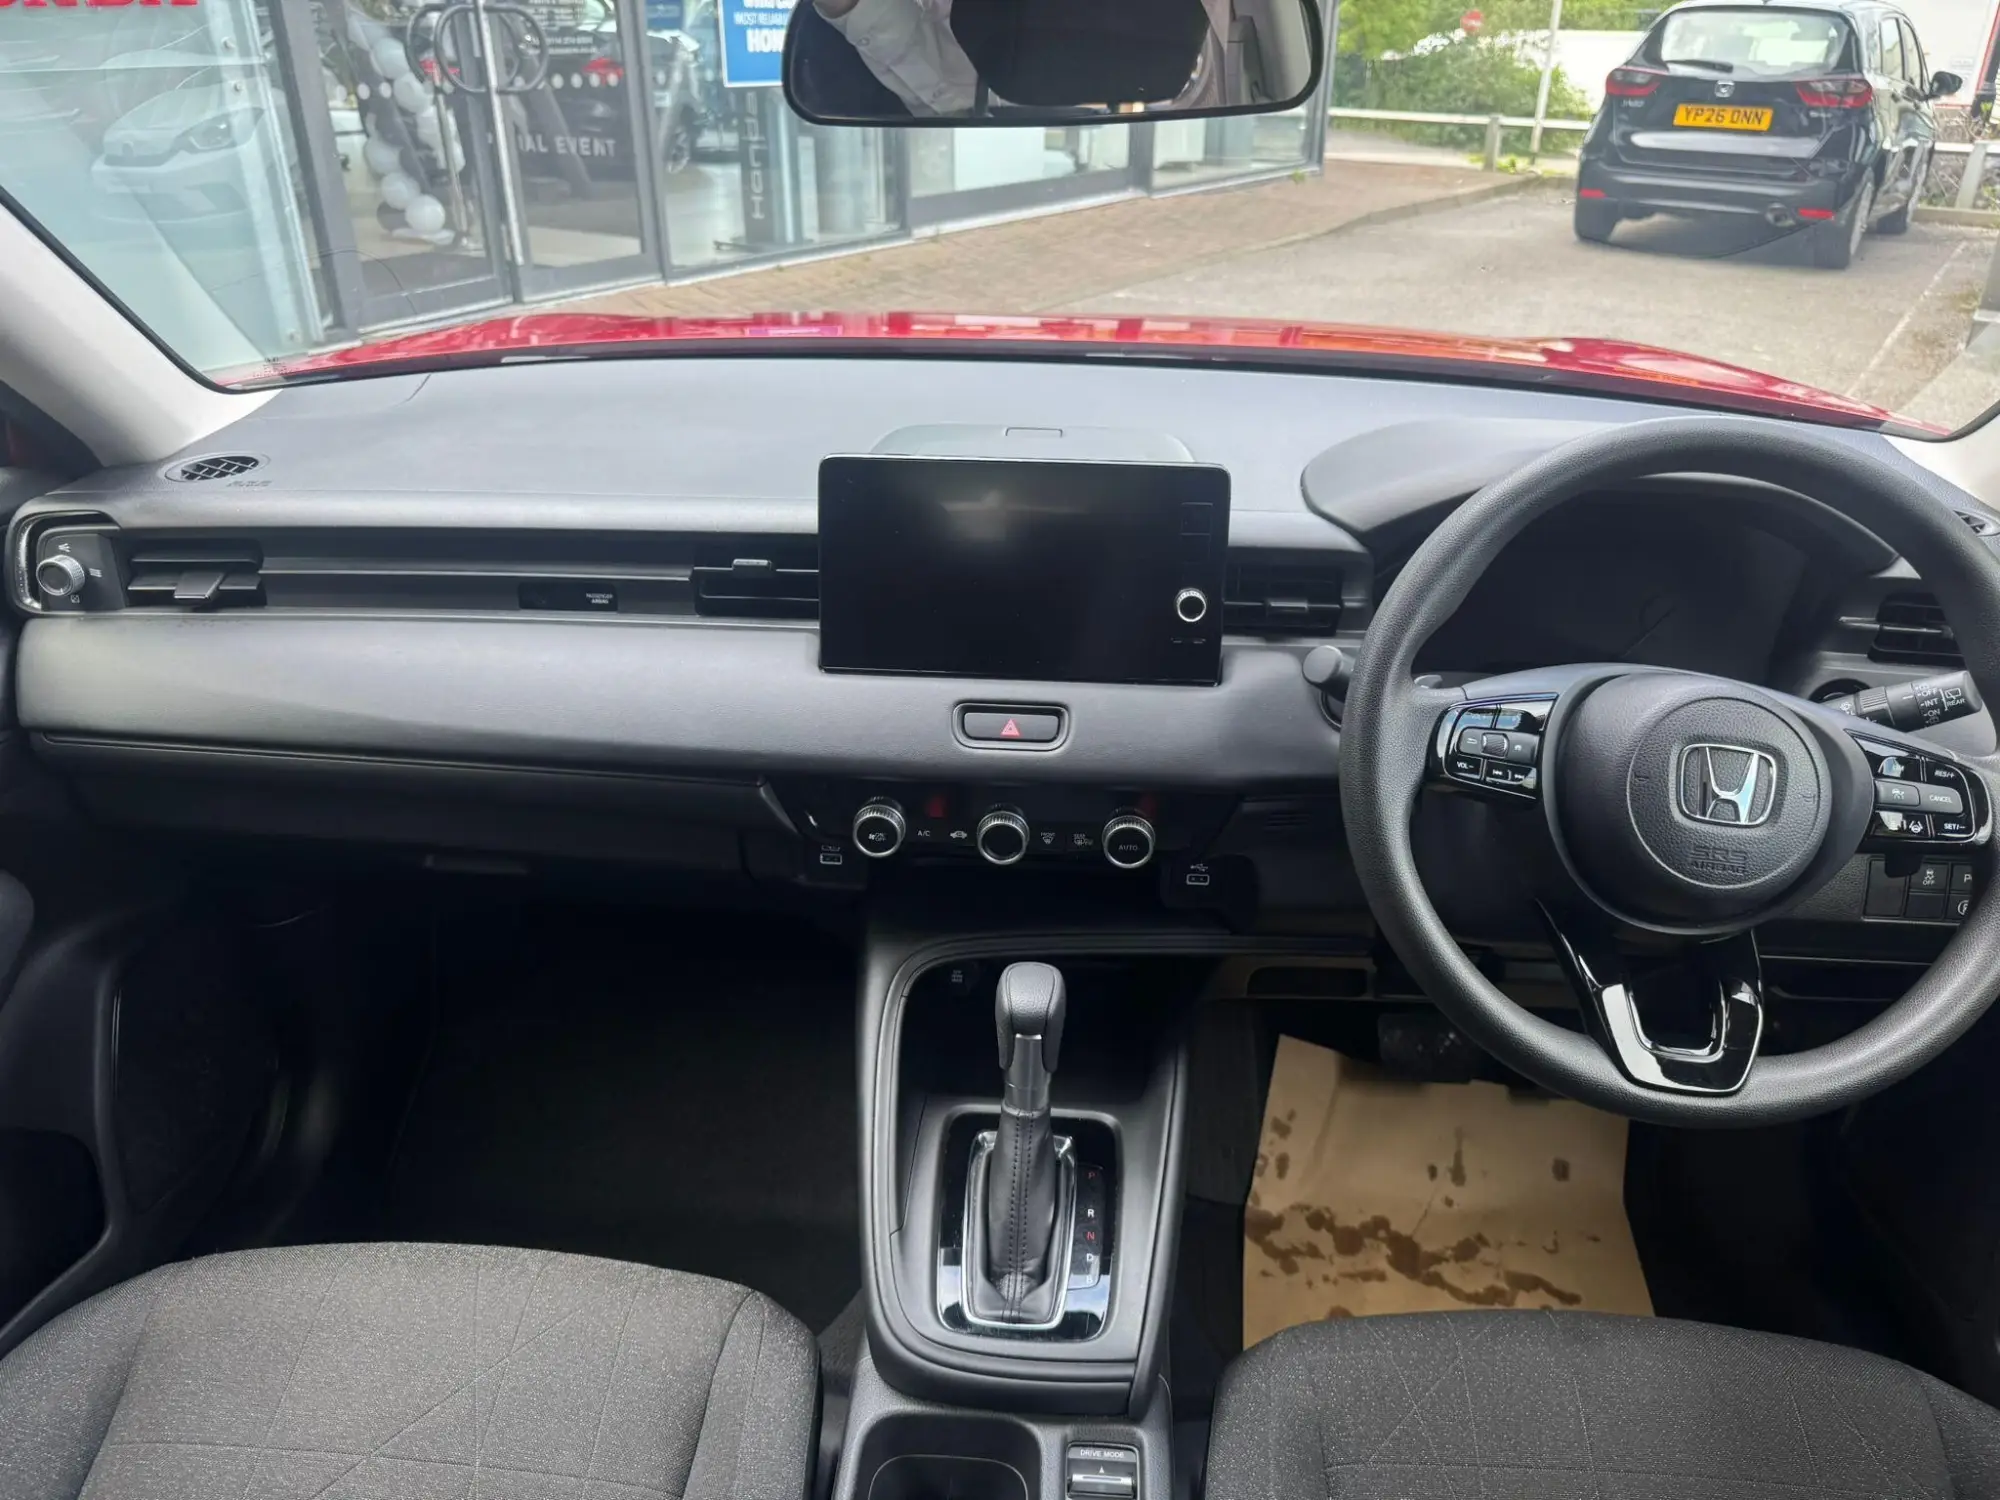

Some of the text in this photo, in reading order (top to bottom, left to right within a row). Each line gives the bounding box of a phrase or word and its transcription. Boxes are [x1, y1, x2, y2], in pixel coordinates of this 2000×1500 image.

[1684, 107, 1726, 124] YP26
[554, 135, 616, 157] EVENT
[1921, 687, 1938, 697] OFF
[1924, 697, 1939, 707] INT
[1946, 698, 1966, 707] REAR
[1927, 708, 1941, 717] ON
[1929, 794, 1952, 804] CANCEL
[1118, 844, 1139, 852] AUTO
[1922, 879, 1936, 887] OFF
[1087, 1208, 1095, 1218] R
[1086, 1231, 1096, 1241] N
[1086, 1253, 1094, 1262] D
[1080, 1449, 1125, 1459] DRIVE MODE
